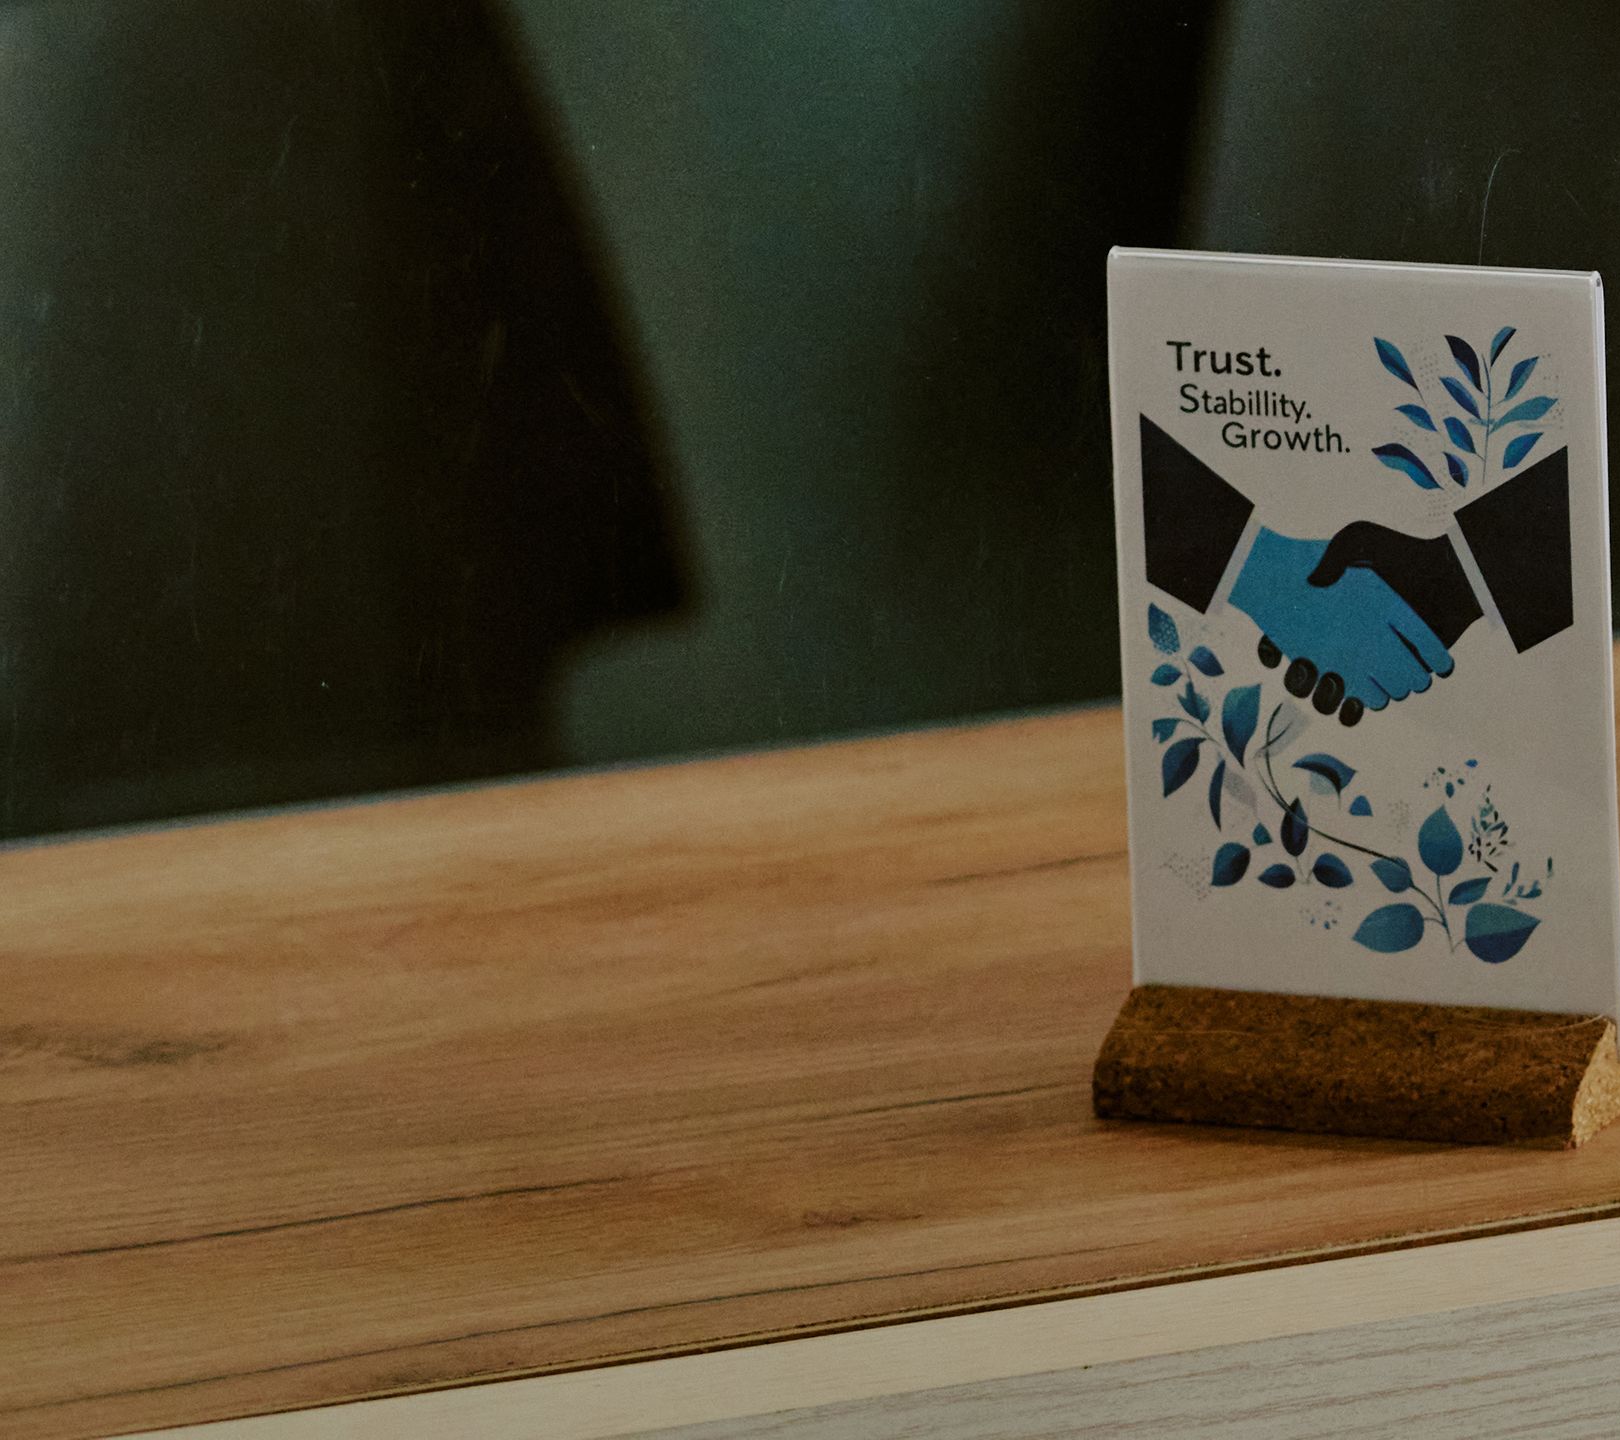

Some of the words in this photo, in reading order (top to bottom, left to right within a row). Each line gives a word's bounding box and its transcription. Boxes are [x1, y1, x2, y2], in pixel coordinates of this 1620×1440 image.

[1166, 340, 1282, 377] Trust.
[1179, 383, 1312, 424] Stabillity.
[1221, 421, 1351, 453] Growth.
